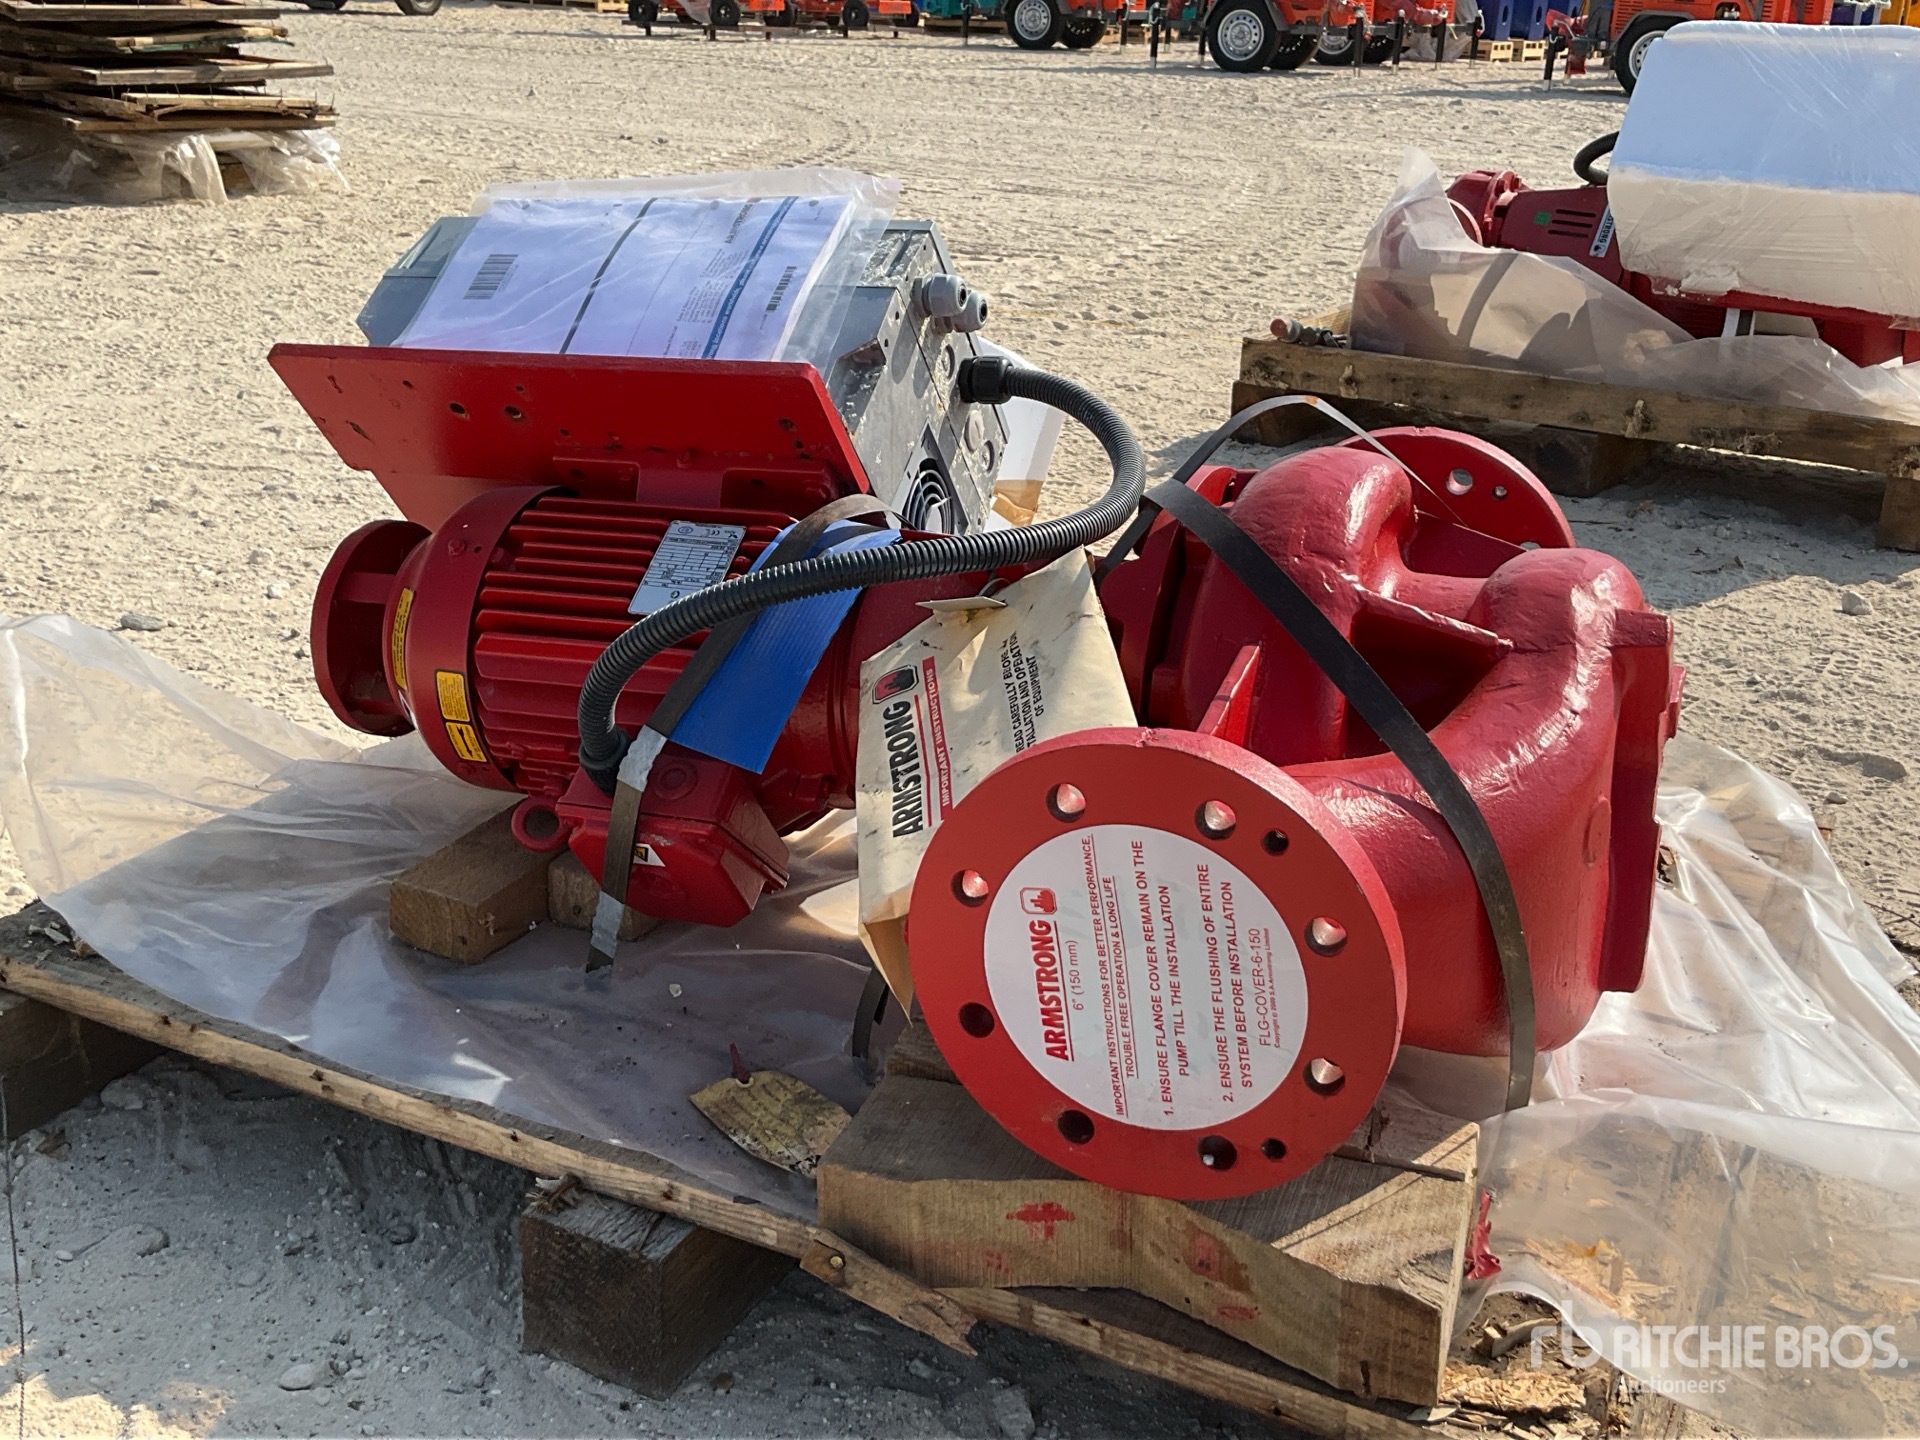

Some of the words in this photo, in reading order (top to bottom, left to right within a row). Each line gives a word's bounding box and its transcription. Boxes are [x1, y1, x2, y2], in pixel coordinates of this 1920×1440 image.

[1018, 680, 1030, 701] AND
[1025, 655, 1043, 702] EQUIPMENT
[926, 668, 944, 745] INSTRUCTIONS
[1004, 681, 1021, 730] CAREFULLY
[1021, 699, 1037, 748] TALLATION
[1034, 704, 1045, 717] OF
[1014, 729, 1025, 753] READ
[883, 700, 924, 838] ARMSTRONG
[936, 748, 950, 806] IMPORTANT
[1131, 840, 1145, 867] THE
[1102, 876, 1114, 899] LIFE
[1135, 870, 1148, 890] ON
[1196, 863, 1213, 913] ENTIRE
[1093, 917, 1107, 957] BETTER
[1105, 901, 1119, 929] LONG
[1110, 930, 1120, 939] &
[1138, 892, 1155, 942] REMAIN
[1158, 885, 1180, 977] INSTALLATION
[1203, 914, 1216, 933] OF
[1220, 881, 1242, 975] INSTALLATION
[1064, 940, 1079, 966] mm)
[1263, 927, 1271, 951] Limited
[1028, 919, 1069, 1061] ARMSTRONG
[1069, 967, 1085, 996] (150
[1098, 959, 1110, 980] FOR
[1112, 941, 1127, 1000] OPERATION
[1145, 945, 1161, 992] COVER
[1206, 936, 1223, 1003] FLUSHING
[1248, 928, 1271, 1046] FLG-COVER-6-150
[1118, 1001, 1130, 1029] FREE
[1169, 980, 1182, 1006] THE
[1230, 978, 1247, 1033] BEFORE
[1100, 983, 1117, 1057] INSTRUCTIONS
[1150, 994, 1167, 1047] FLANGE
[1172, 1009, 1186, 1036] TILL
[1212, 1006, 1226, 1032] THE
[1272, 1018, 1281, 1049] Copyright
[1121, 1030, 1135, 1078] TROUBLE
[1156, 1050, 1173, 1103] ENSURE
[1175, 1040, 1190, 1077] PUMP
[1215, 1035, 1232, 1088] ENSURE
[1236, 1036, 1253, 1088] SYSTEM
[1109, 1060, 1125, 1116] IMPORTANT
[1163, 1105, 1175, 1116] 1.
[1222, 1091, 1234, 1103] 2.
